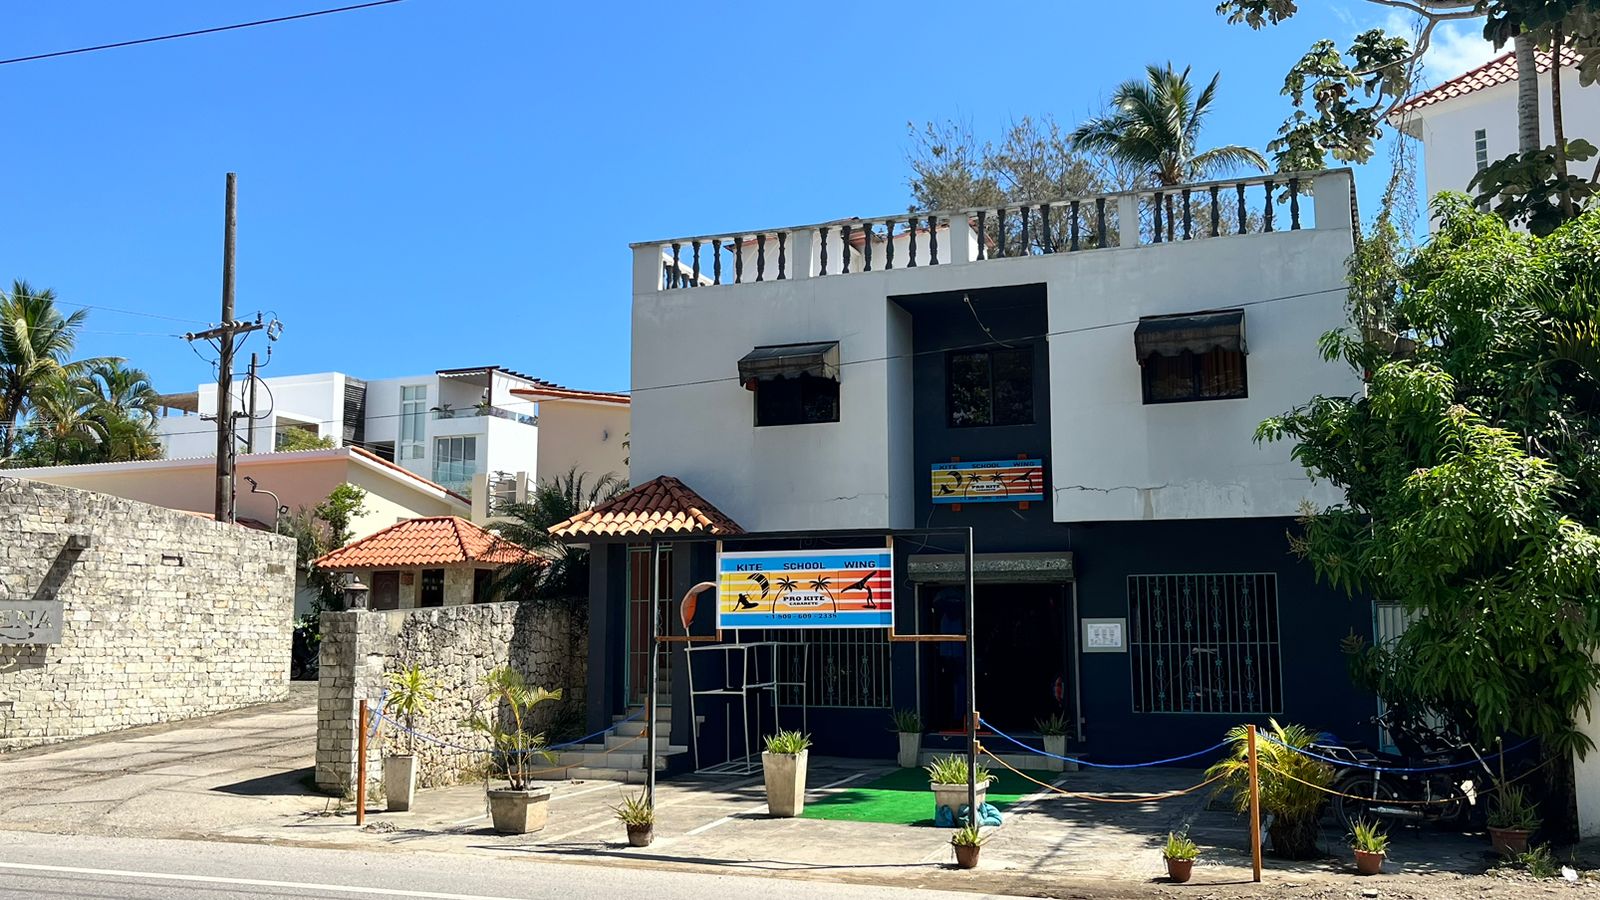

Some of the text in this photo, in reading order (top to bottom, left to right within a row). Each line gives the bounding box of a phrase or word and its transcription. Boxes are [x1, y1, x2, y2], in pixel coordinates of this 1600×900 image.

[736, 560, 876, 571] KITE SCHOOL WING
